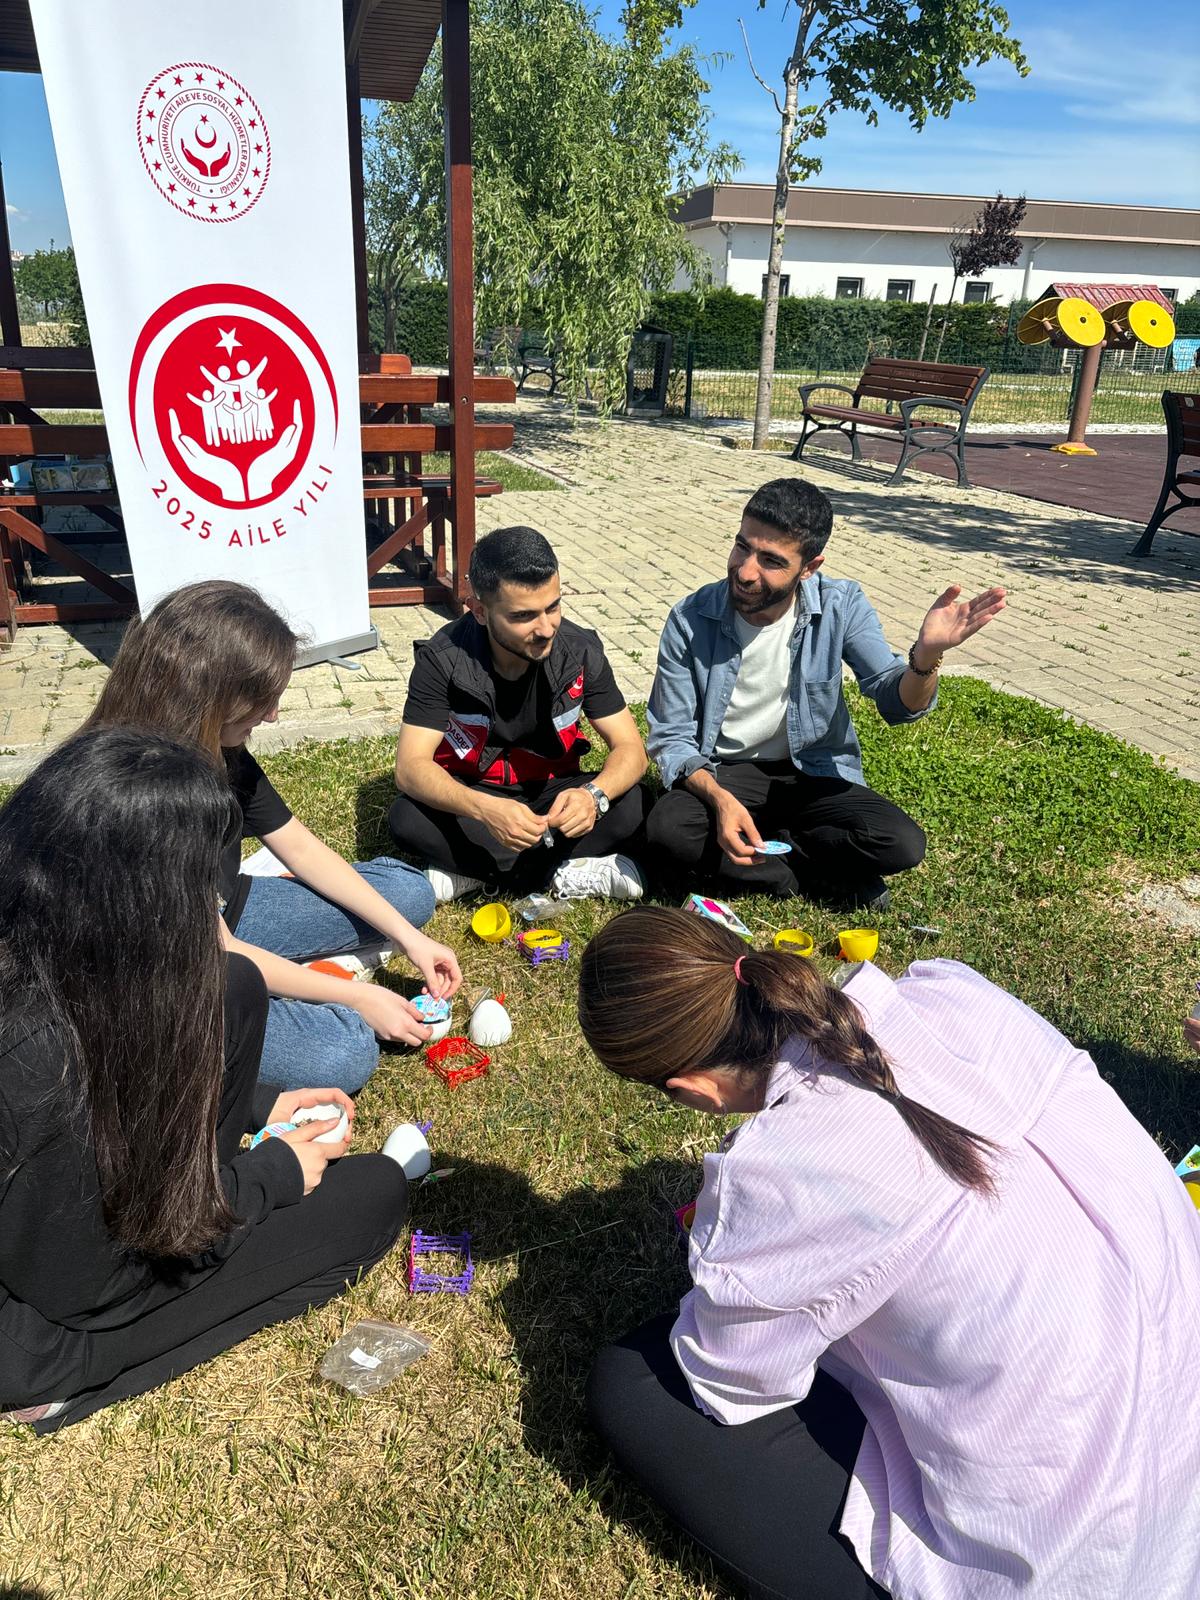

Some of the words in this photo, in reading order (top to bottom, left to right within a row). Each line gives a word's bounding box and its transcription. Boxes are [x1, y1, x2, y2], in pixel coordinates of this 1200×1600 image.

[176, 94, 191, 108] AİLE
[191, 92, 201, 101] VE
[202, 93, 229, 114] SOSYAL
[161, 103, 178, 164] CUMHURİYETİ
[229, 111, 248, 160] HİZMETLER
[172, 165, 201, 193] TÜRKİYE
[220, 161, 246, 194] BAKANLIĞI
[152, 480, 212, 540] 2025
[228, 518, 287, 547] AİLE
[293, 465, 332, 516] YILI
